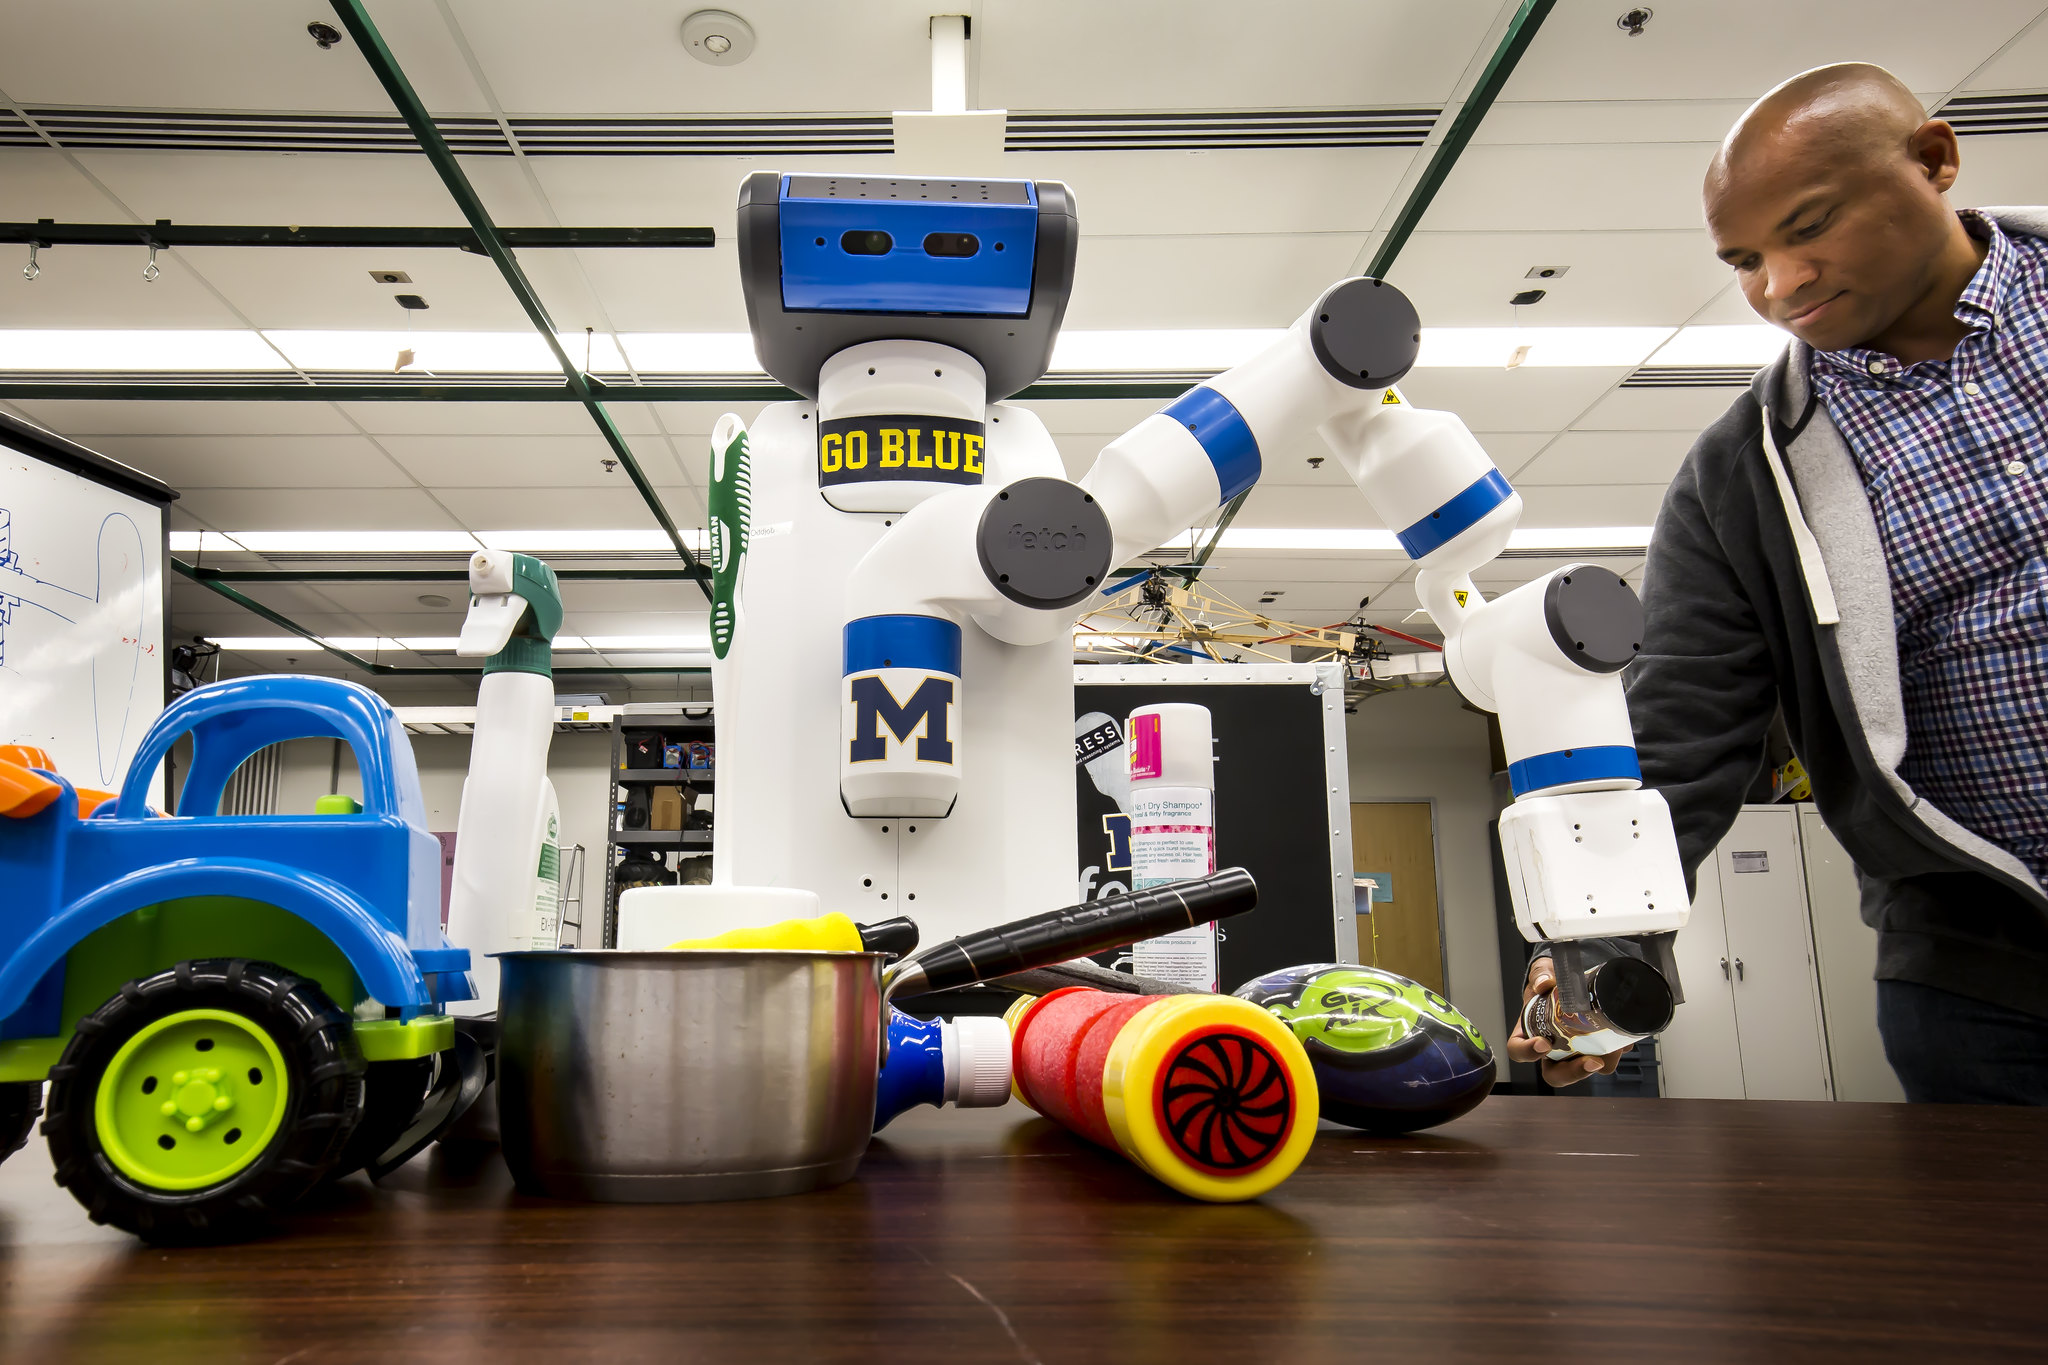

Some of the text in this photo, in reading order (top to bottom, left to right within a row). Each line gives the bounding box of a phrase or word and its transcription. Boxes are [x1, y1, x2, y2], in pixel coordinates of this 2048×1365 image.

[821, 428, 984, 474] GO BLUE
[710, 515, 721, 569] LIBMAN
[1008, 523, 1087, 552] fetch
[849, 674, 954, 766] M
[1148, 801, 1160, 811] Dry
[1162, 810, 1192, 818] fragrance
